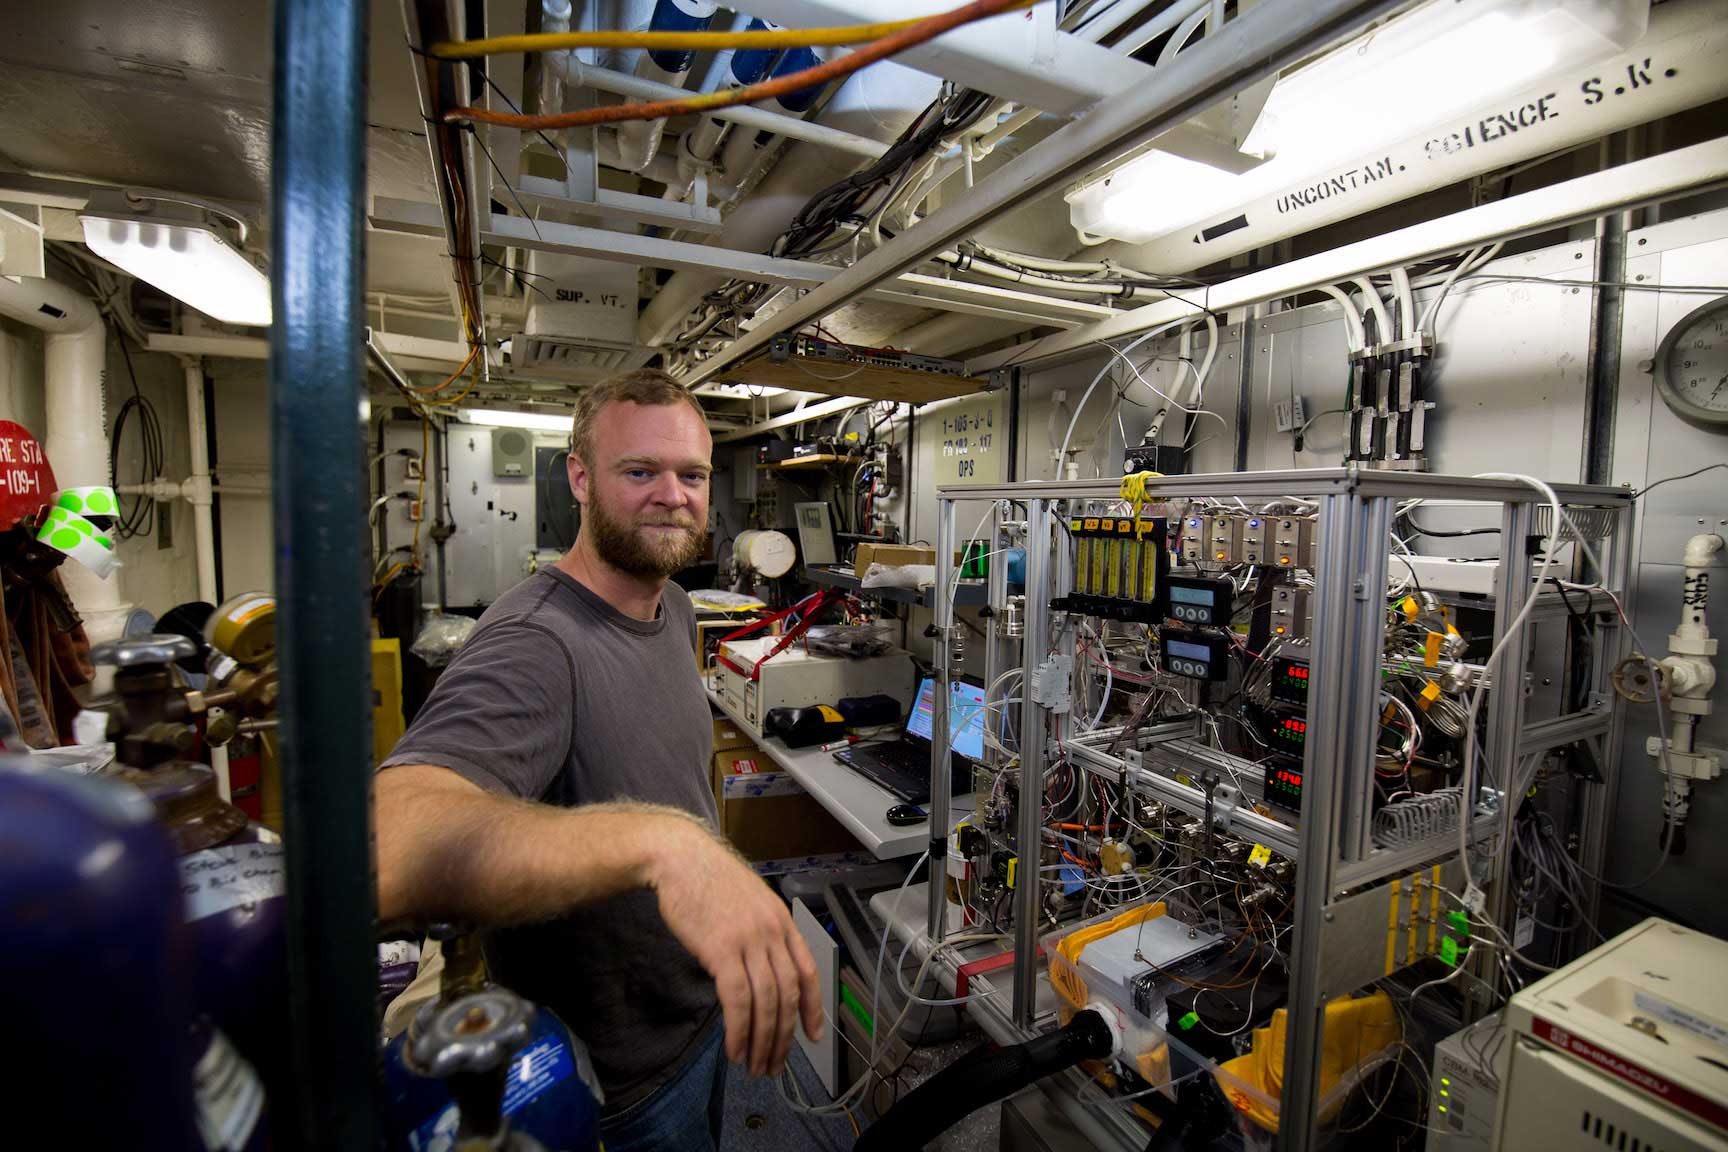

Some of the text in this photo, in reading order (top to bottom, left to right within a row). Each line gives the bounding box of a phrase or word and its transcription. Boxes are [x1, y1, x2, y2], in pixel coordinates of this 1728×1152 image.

[1276, 156, 1406, 214] UNCONTAM.
[1424, 92, 1559, 160] SCIENCE
[556, 288, 591, 304] SUP.
[21, 440, 43, 465] STA
[958, 459, 975, 478] OPS
